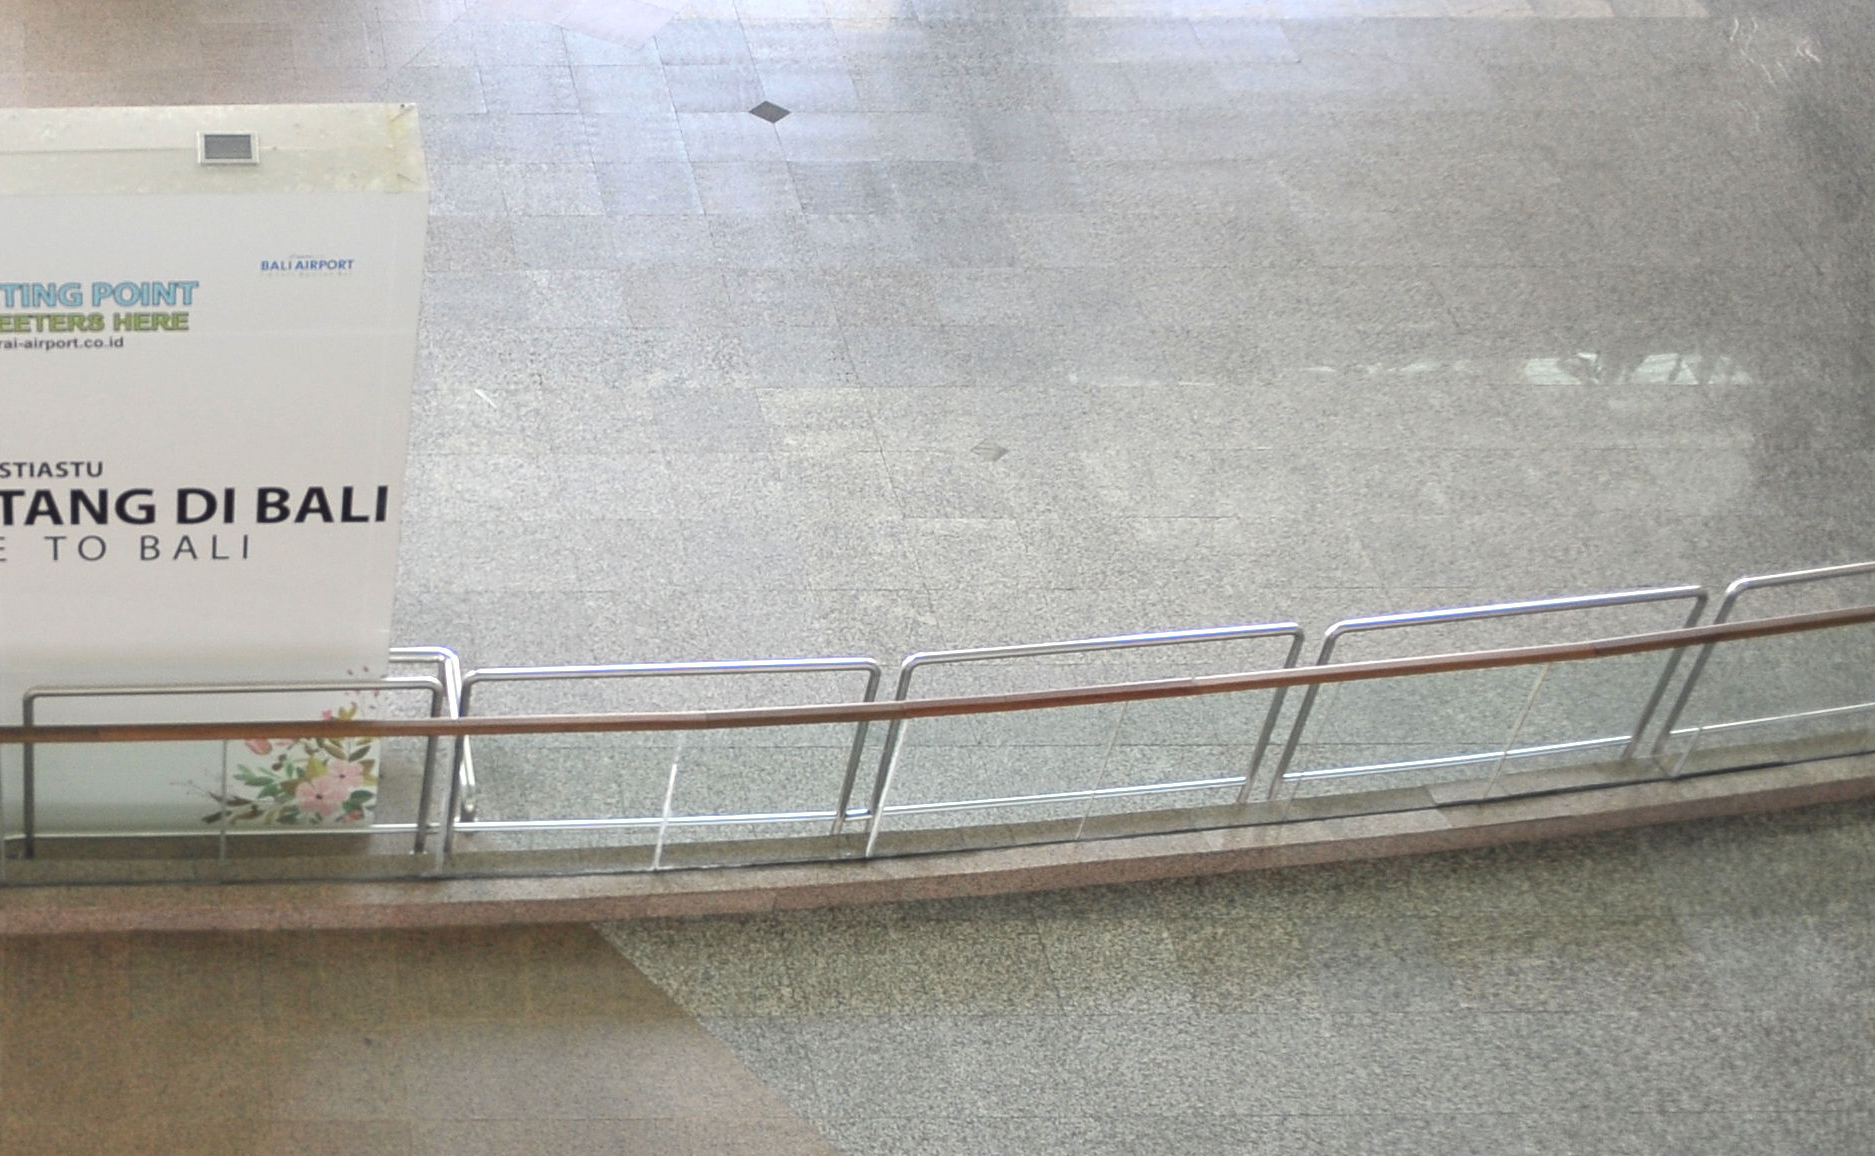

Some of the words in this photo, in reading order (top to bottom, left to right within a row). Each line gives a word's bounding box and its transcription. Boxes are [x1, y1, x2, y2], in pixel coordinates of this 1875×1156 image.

[261, 260, 292, 271] BALI
[295, 259, 354, 270] AIRPORT
[91, 281, 199, 307] POINT
[112, 312, 190, 331] HERE
[176, 488, 235, 524] DI
[256, 485, 389, 523] BALI
[43, 535, 107, 562] TO
[140, 534, 250, 561] BALI
